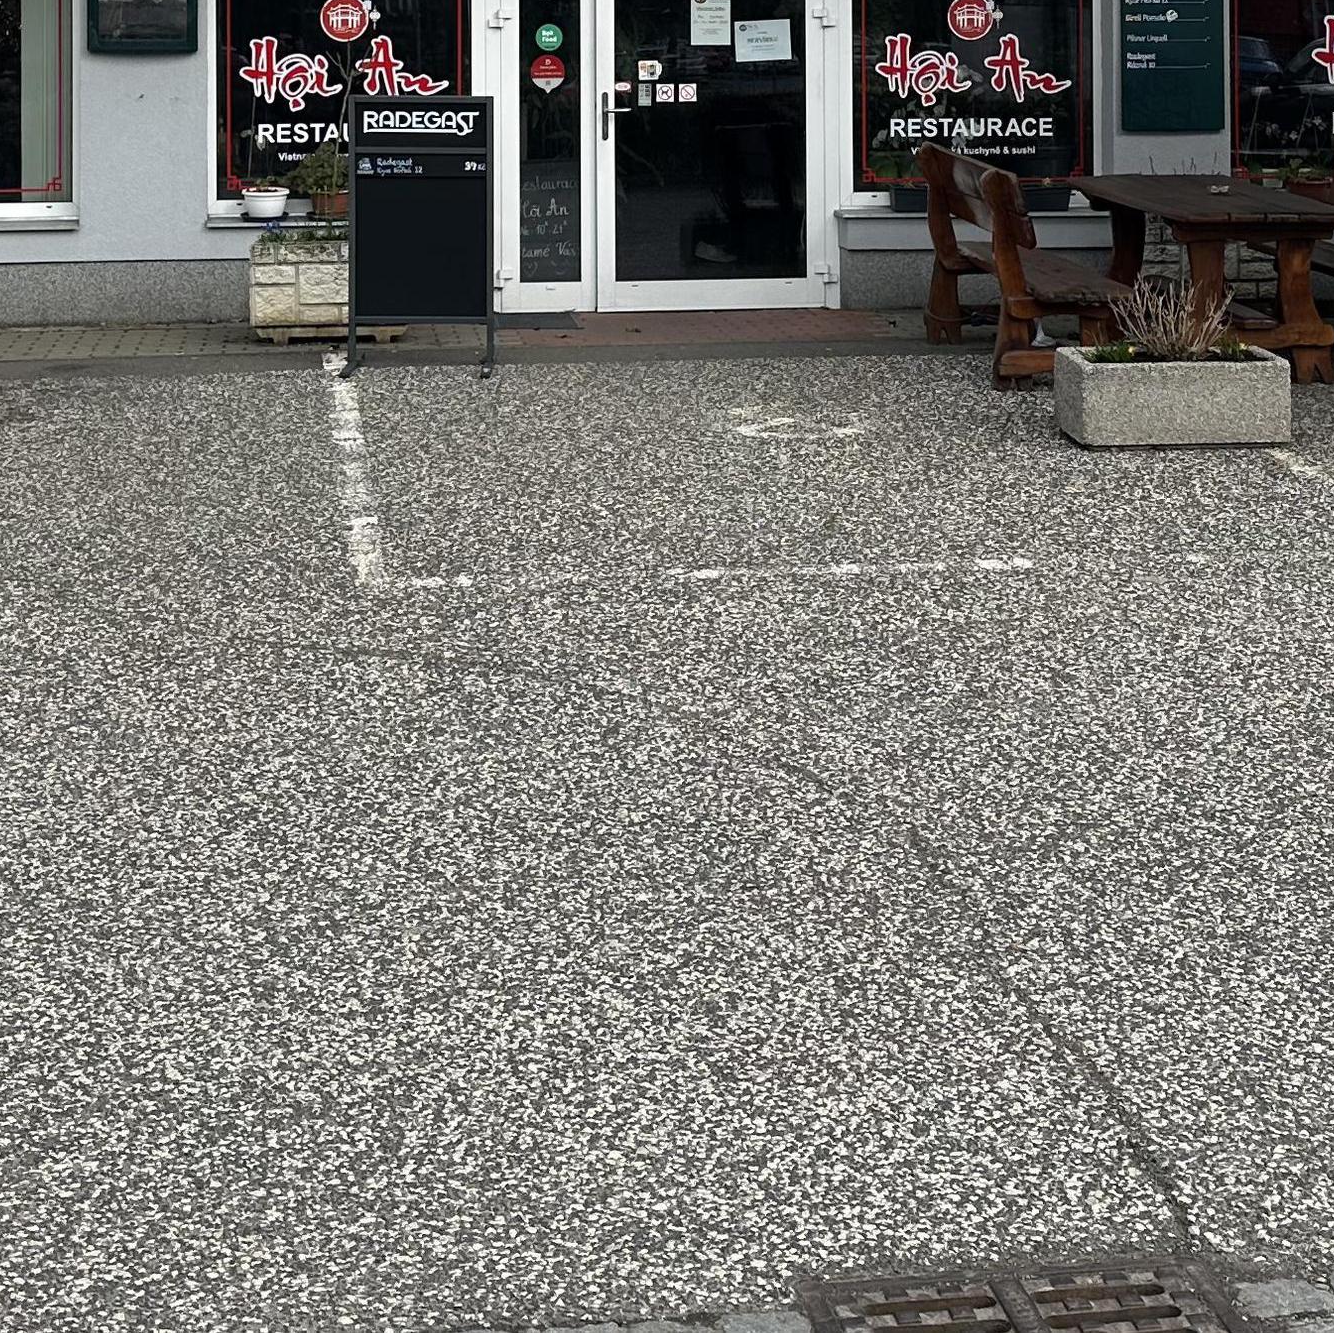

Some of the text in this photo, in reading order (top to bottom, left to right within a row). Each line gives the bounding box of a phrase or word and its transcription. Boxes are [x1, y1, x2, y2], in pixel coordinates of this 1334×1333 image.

[355, 35, 450, 96] An
[984, 33, 1073, 103] An
[362, 111, 479, 136] RADEGAST
[889, 117, 1054, 137] RESTAURACE
[1012, 146, 1036, 154] sushi
